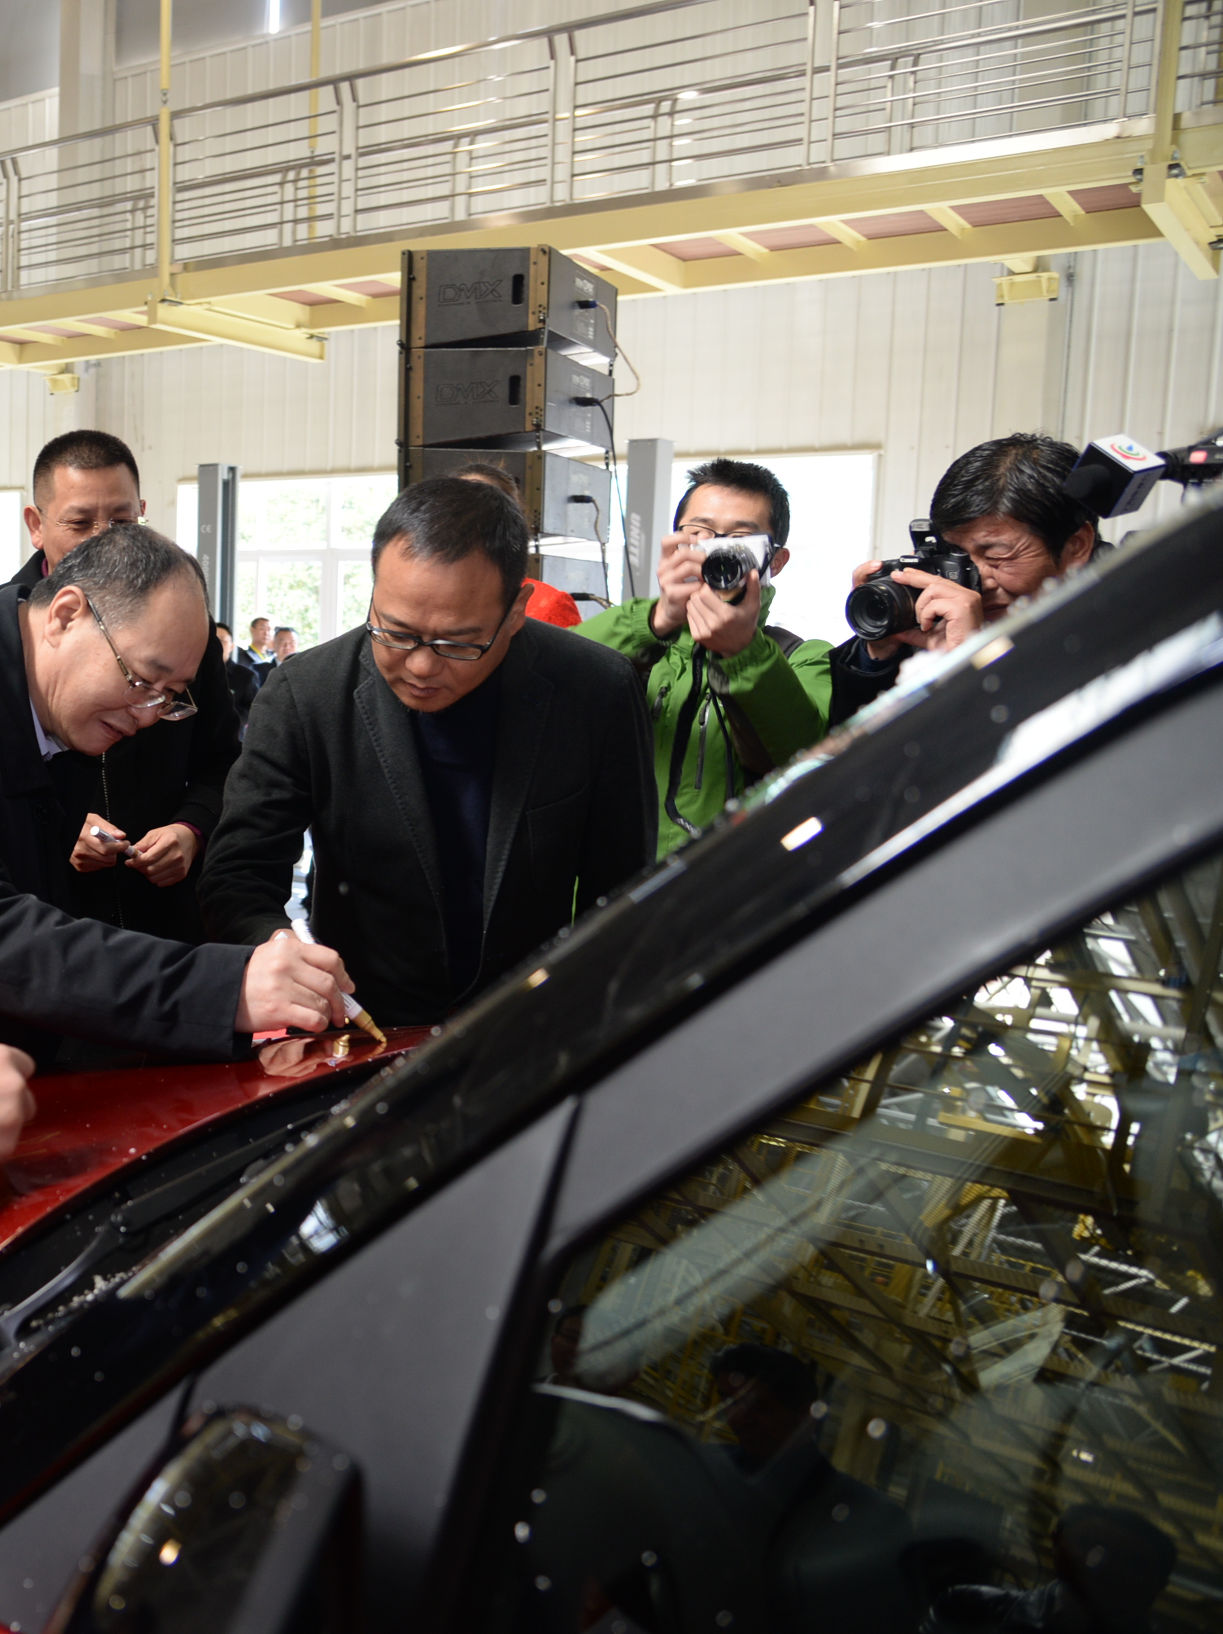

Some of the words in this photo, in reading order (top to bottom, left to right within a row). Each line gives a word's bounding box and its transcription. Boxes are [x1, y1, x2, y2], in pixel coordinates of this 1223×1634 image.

[438, 280, 503, 303] DMX
[435, 380, 499, 402] DMX
[200, 524, 212, 534] CE
